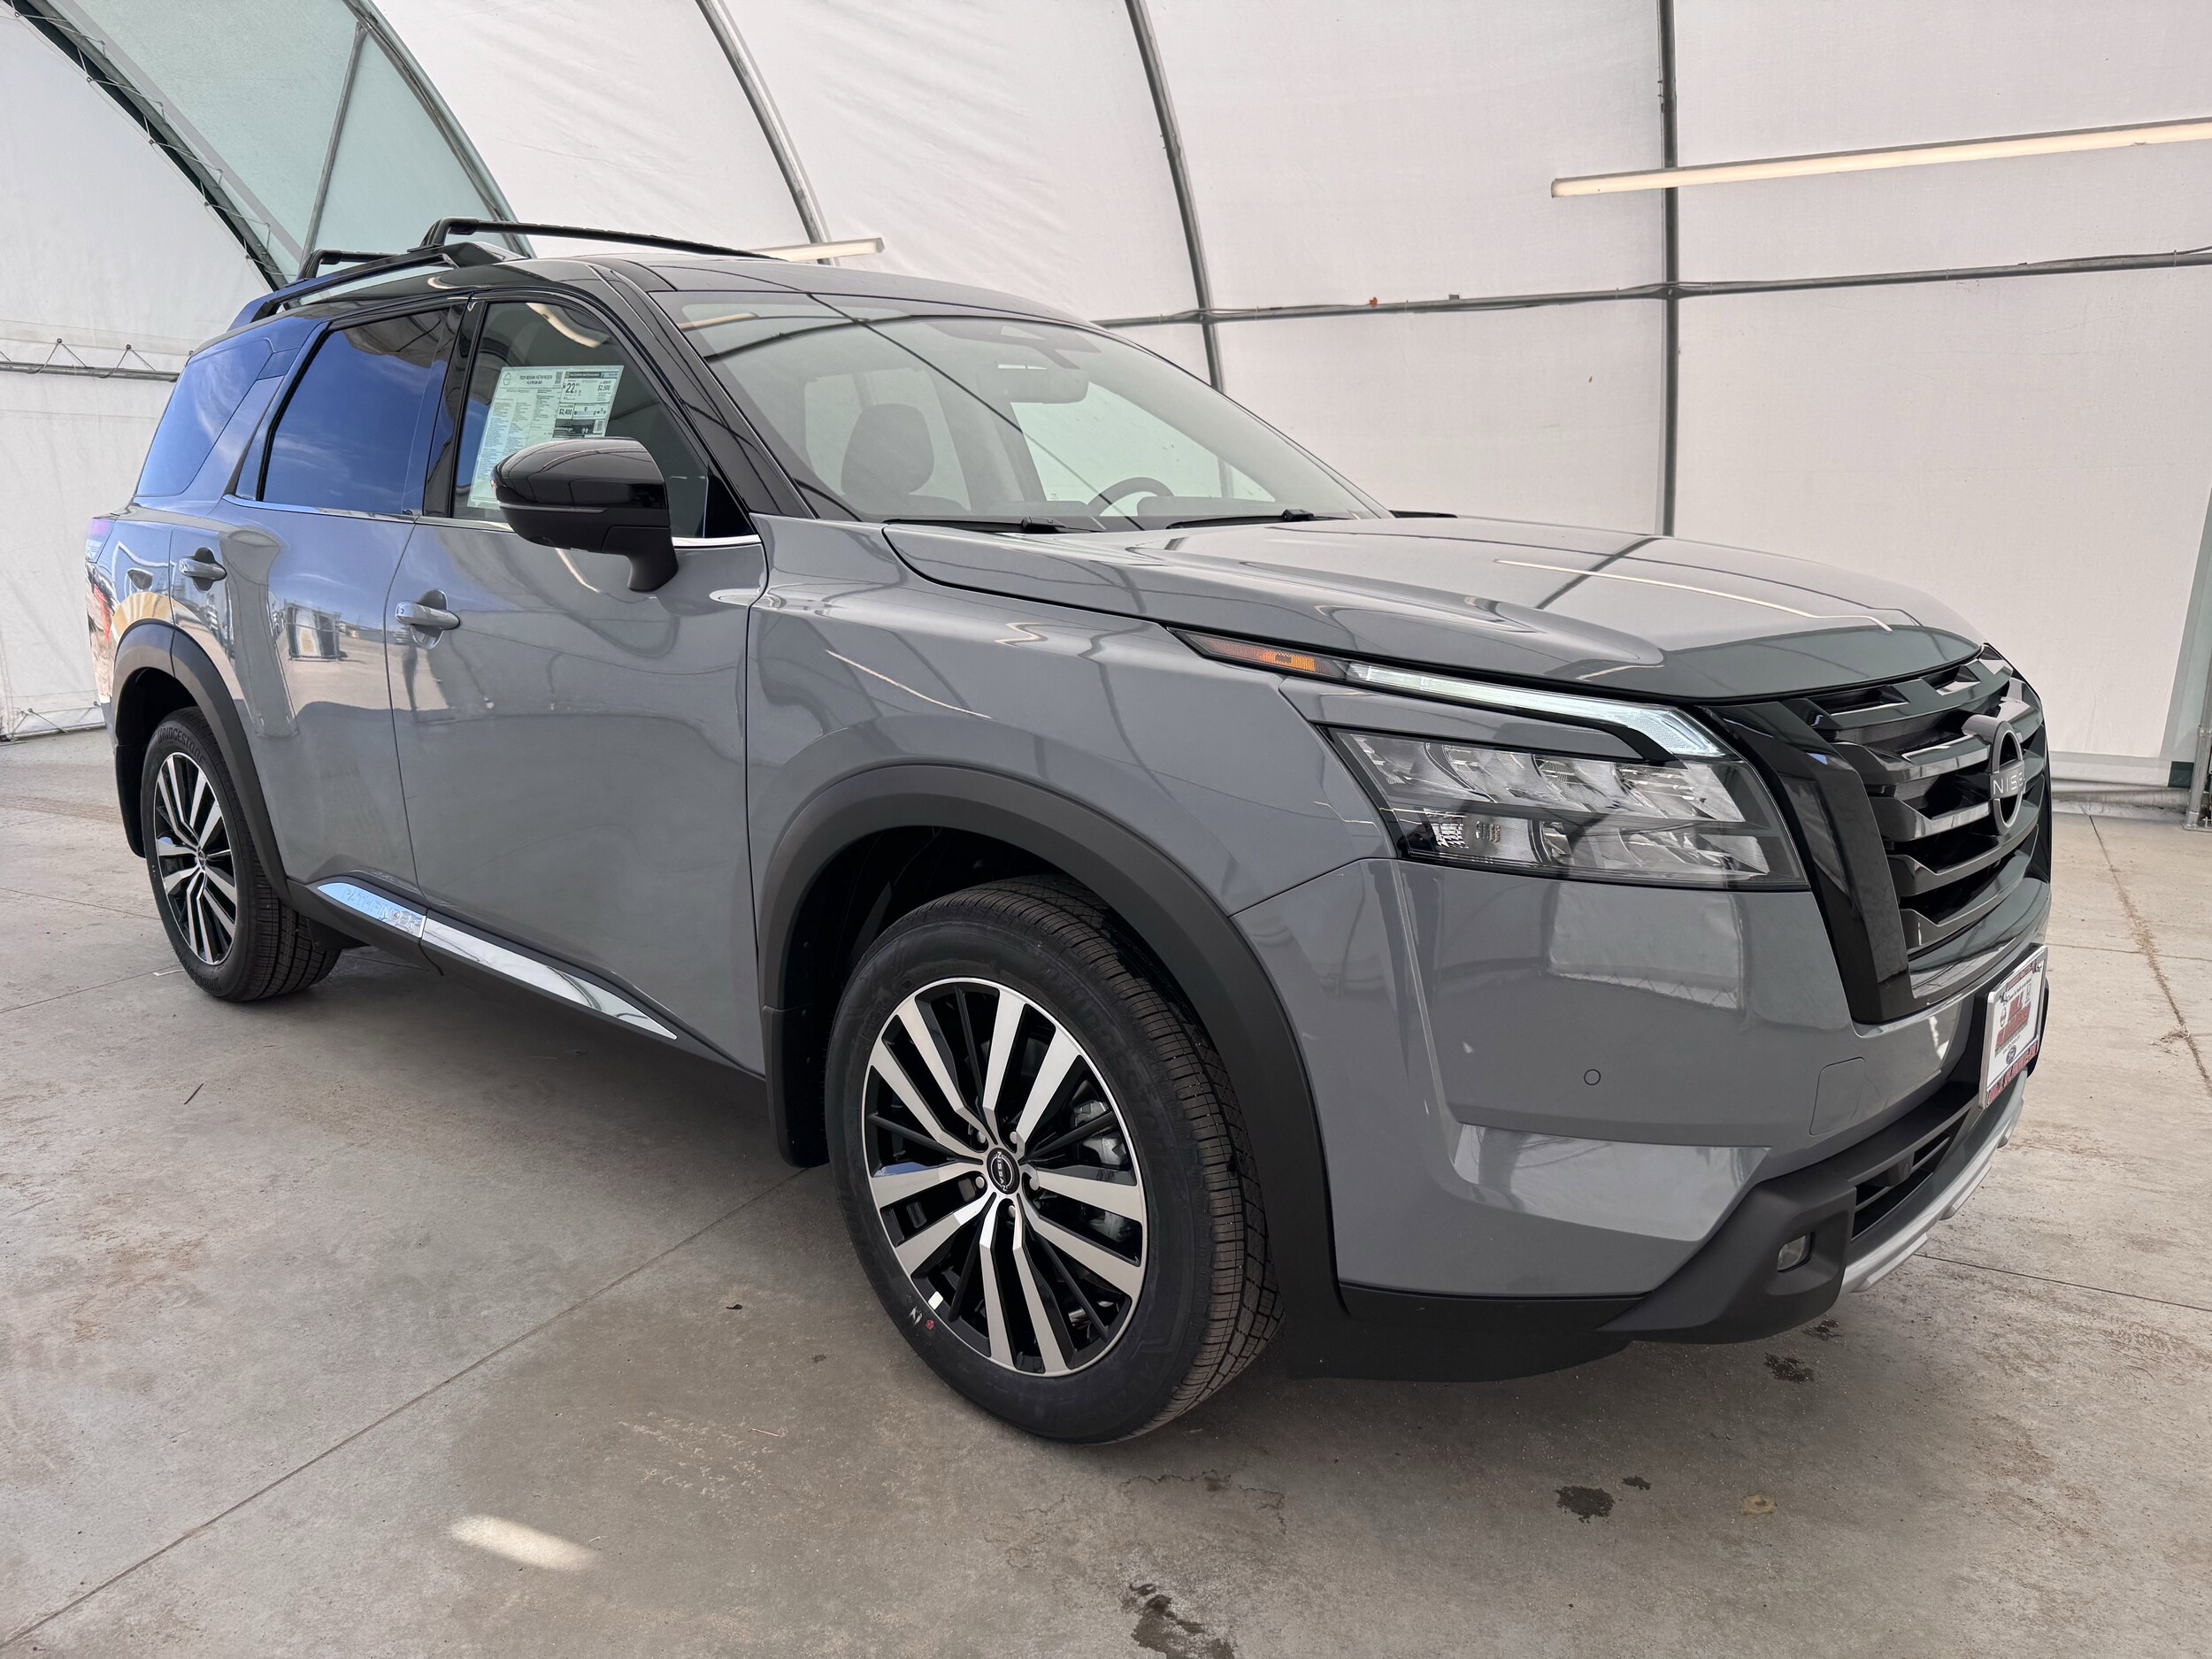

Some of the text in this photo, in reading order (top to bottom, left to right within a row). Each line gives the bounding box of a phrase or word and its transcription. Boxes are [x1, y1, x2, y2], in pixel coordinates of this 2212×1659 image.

[565, 383, 576, 394] 22
[157, 726, 205, 764] BRIDGESTONE
[1993, 772, 2025, 795] NISS
[342, 887, 419, 931] PATHFINDER
[996, 1150, 1009, 1192] NISSAN
